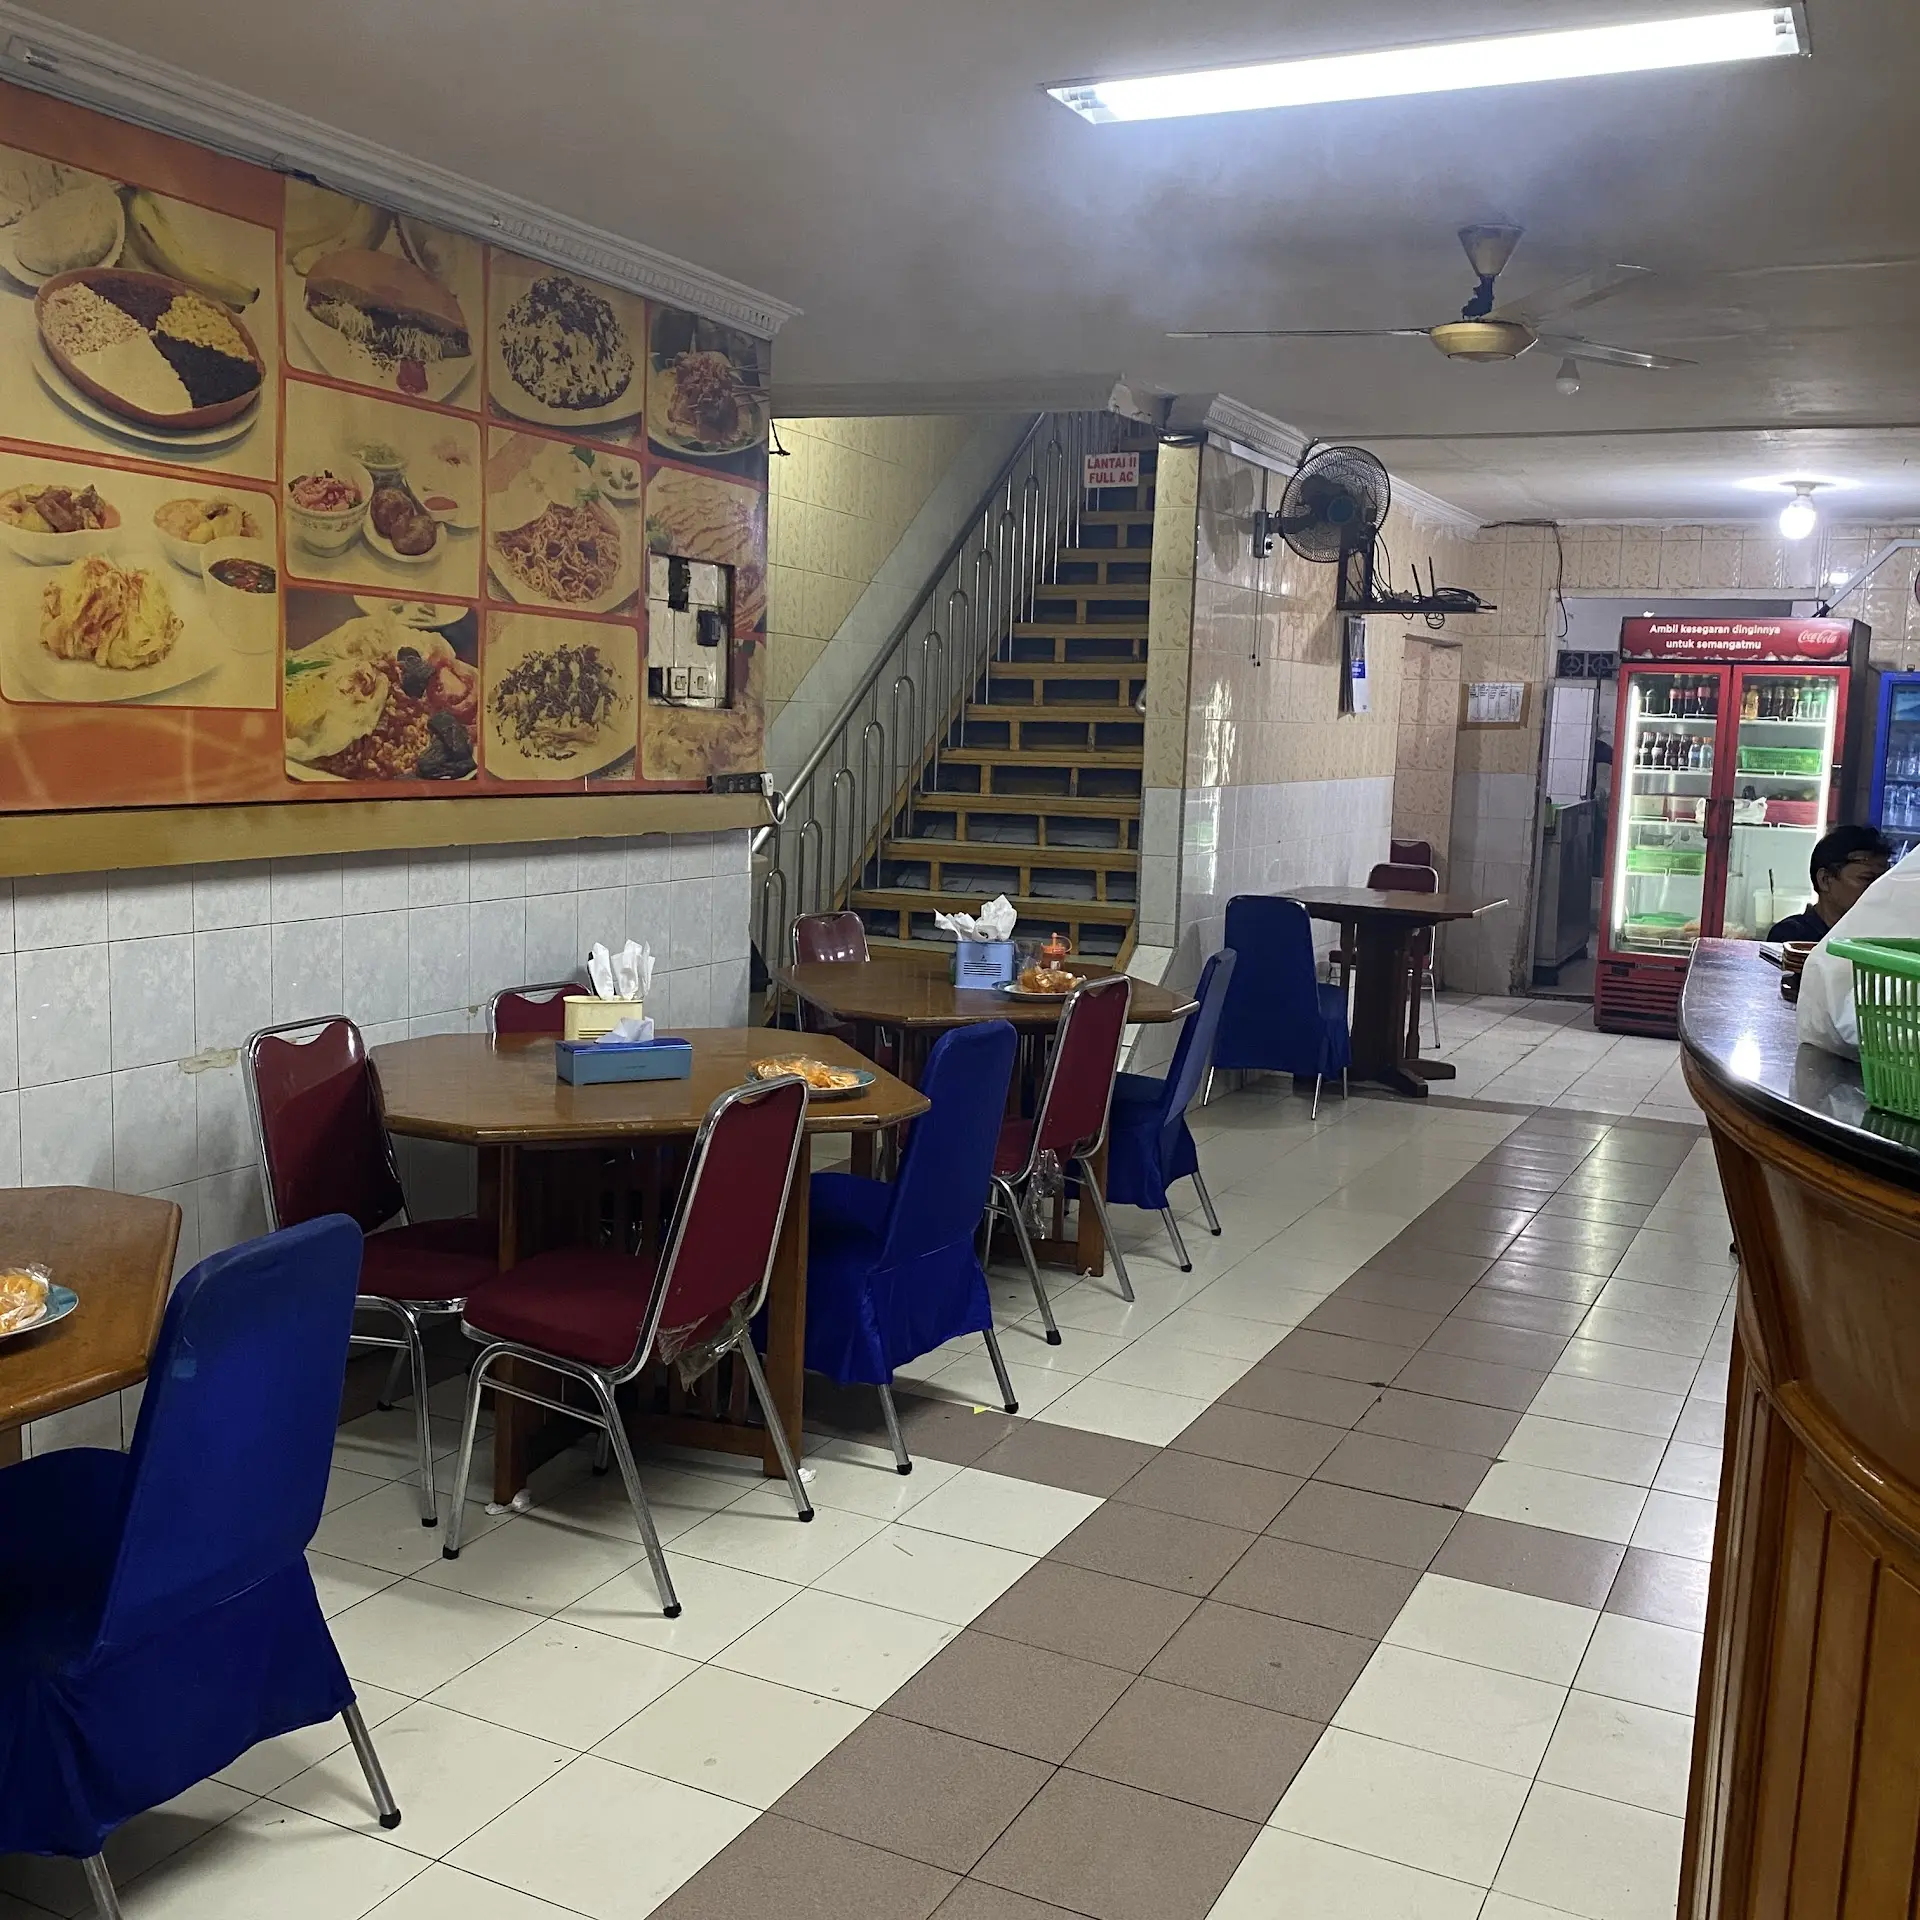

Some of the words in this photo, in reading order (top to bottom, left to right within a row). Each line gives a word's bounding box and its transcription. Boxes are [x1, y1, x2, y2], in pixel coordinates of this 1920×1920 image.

[1087, 457, 1126, 469] LANTAI
[1088, 472, 1116, 484] FULL
[1118, 471, 1134, 483] AC
[1649, 624, 1679, 634] Ambil
[1680, 624, 1730, 635] kesegaran
[1732, 624, 1781, 635] dinginnya
[1666, 639, 1695, 649] untuk
[1696, 639, 1762, 651] semangatmu
